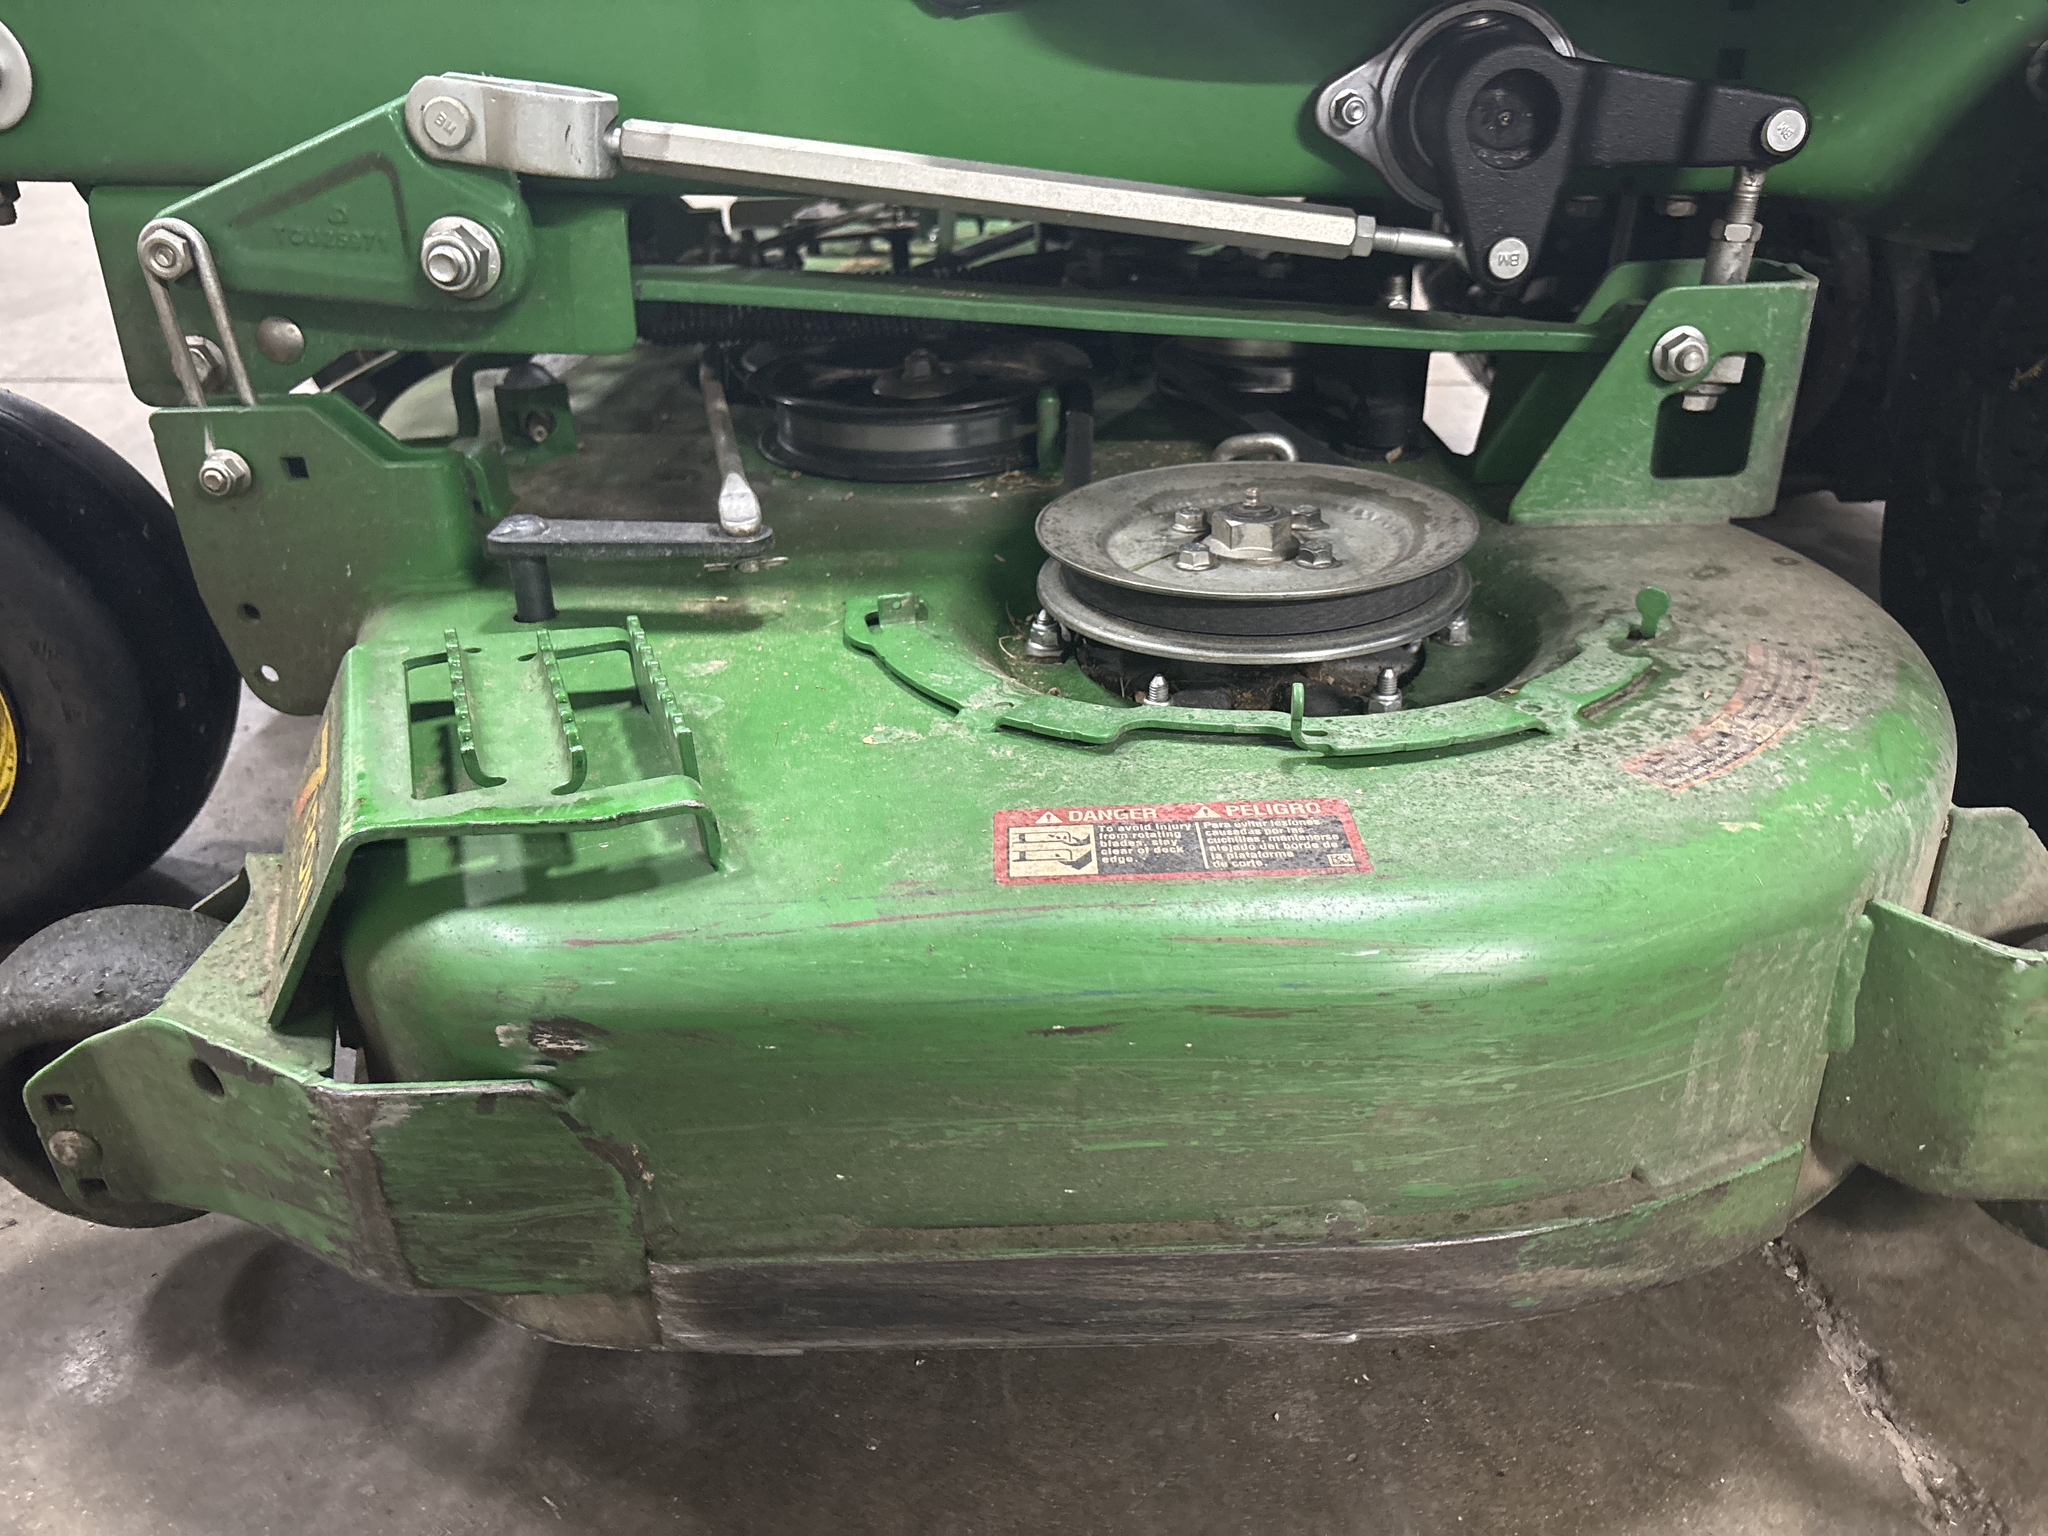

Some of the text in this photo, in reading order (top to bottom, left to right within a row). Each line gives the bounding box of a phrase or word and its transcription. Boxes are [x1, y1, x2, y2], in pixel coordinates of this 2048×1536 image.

[1225, 803, 1321, 816] PELIGRO
[1068, 809, 1158, 821] DANGER
[1098, 824, 1114, 833] To
[1116, 822, 1152, 832] avoid
[1203, 818, 1321, 829] Para evitar lesiones
[1099, 830, 1181, 840] from rotating
[1205, 826, 1305, 836] causadas por las
[1151, 838, 1178, 847] stay
[1268, 833, 1339, 842] mantenerse
[1100, 845, 1184, 855] clear of deck
[1208, 840, 1338, 852] alejado del borde de
[1101, 855, 1138, 864] edge.
[1210, 849, 1295, 860] la plataforma
[1212, 858, 1268, 868] de corte.
